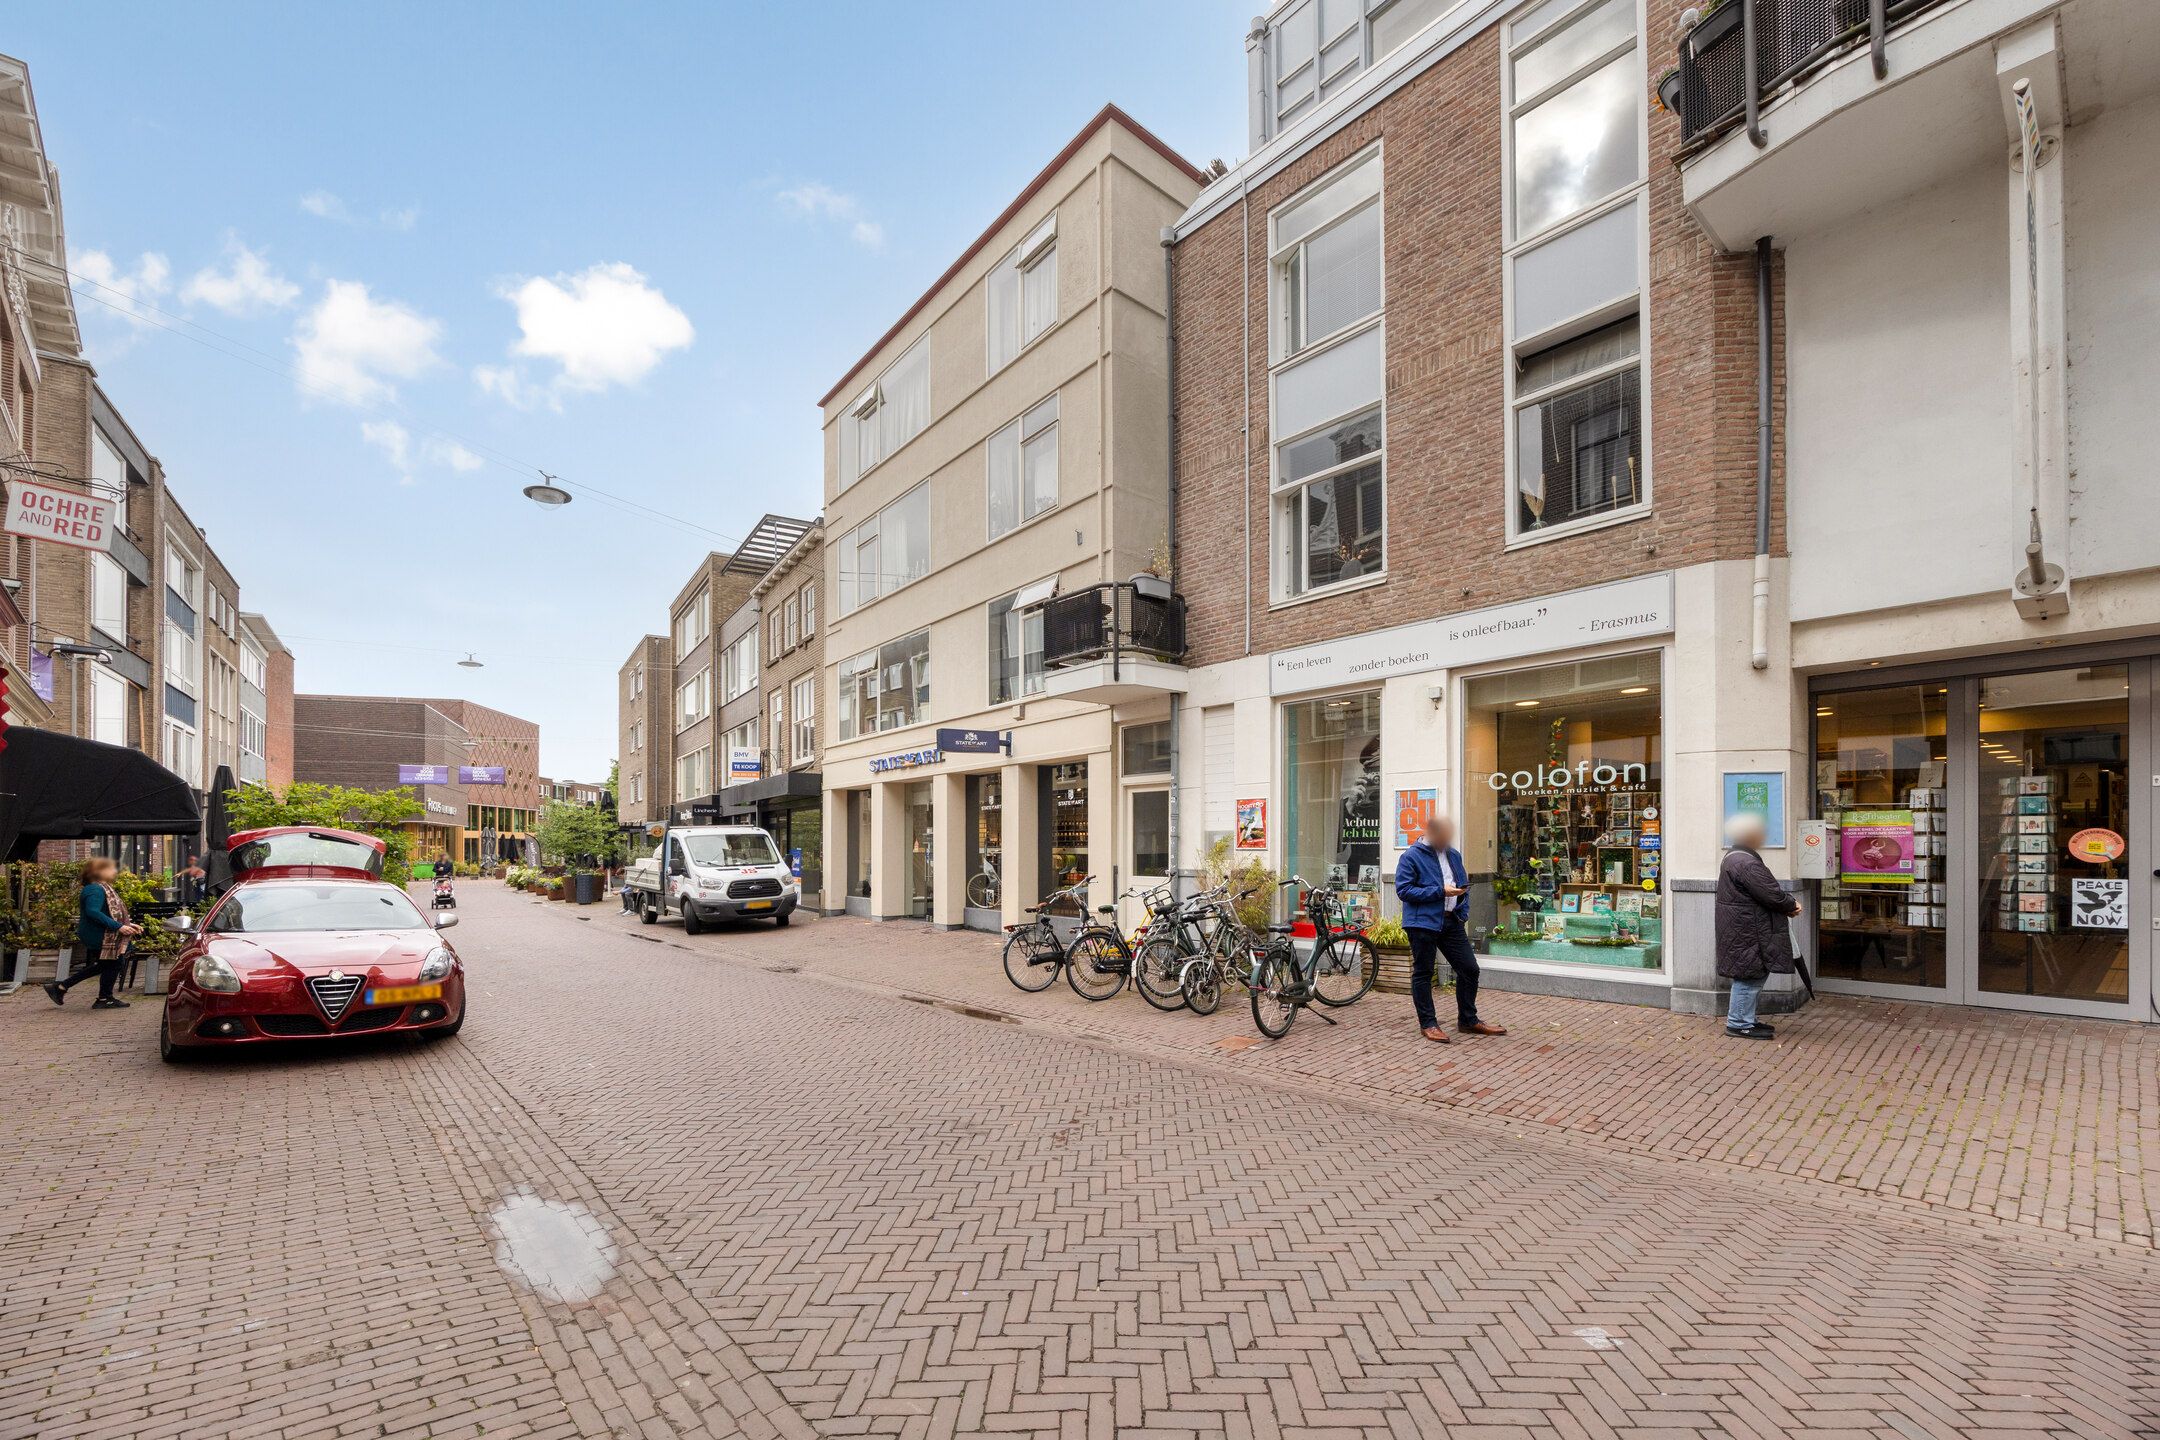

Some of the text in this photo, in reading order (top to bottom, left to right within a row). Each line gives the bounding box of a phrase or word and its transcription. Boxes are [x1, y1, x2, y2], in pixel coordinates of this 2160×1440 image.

[21, 491, 105, 523] OCHRE
[18, 510, 102, 541] AND RED
[1590, 611, 1657, 632] Erasmus
[1449, 630, 1459, 641] is
[1306, 656, 1332, 668] leven
[1349, 652, 1430, 673] zonder boeken
[869, 755, 903, 773] STATE
[914, 748, 945, 766] ART
[1488, 760, 1646, 791] colofon
[1521, 788, 1563, 796] boeken,
[1566, 785, 1606, 794] muziek
[1621, 782, 1647, 791] café
[2076, 881, 2123, 890] PEACE
[2076, 914, 2123, 926] NOW
